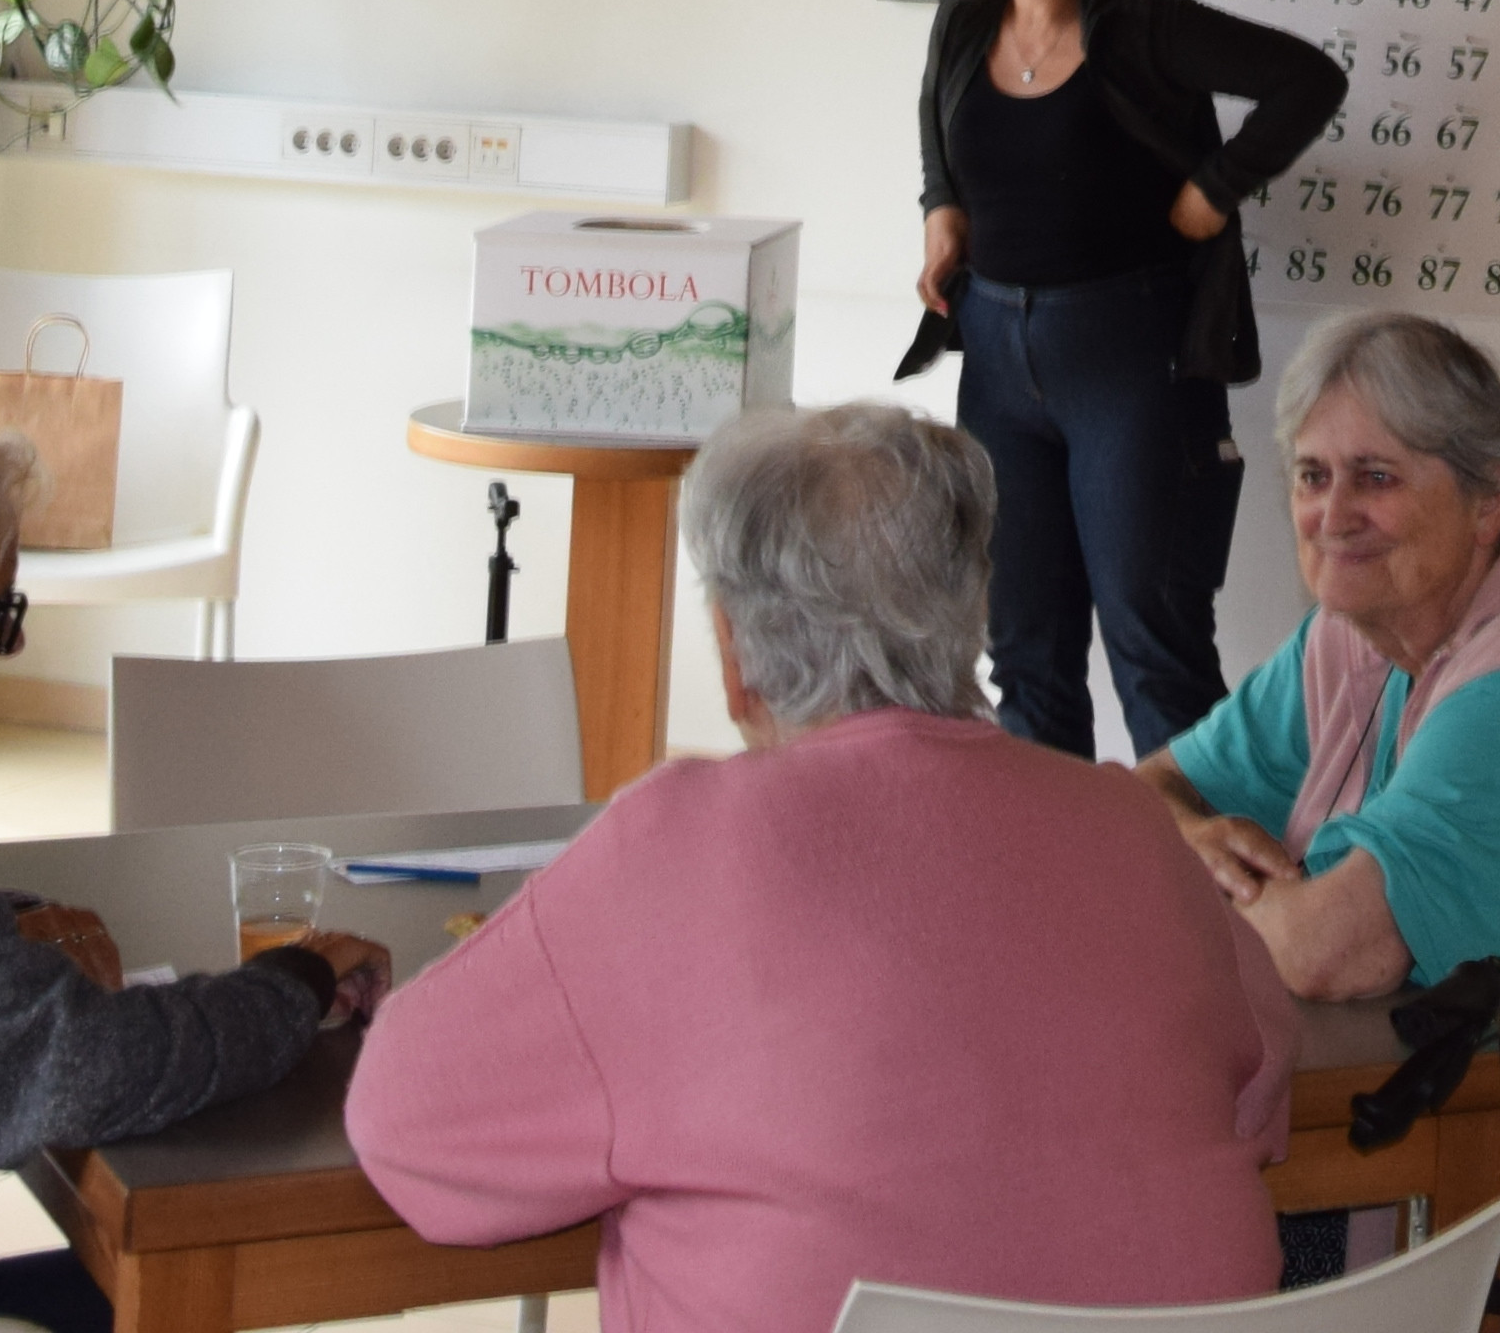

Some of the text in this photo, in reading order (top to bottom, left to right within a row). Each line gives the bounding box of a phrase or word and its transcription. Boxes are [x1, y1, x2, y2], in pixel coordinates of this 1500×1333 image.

[1380, 42, 1423, 79] 56
[1446, 46, 1490, 83] 57
[1369, 114, 1413, 148] 66
[1435, 115, 1481, 152] 67
[1297, 176, 1339, 214] 75
[1362, 179, 1404, 218] 76
[1428, 183, 1472, 223] 77
[520, 265, 700, 303] TOMBOLA
[1284, 247, 1329, 284] 85
[1350, 252, 1394, 289] 86
[1416, 256, 1462, 293] 87
